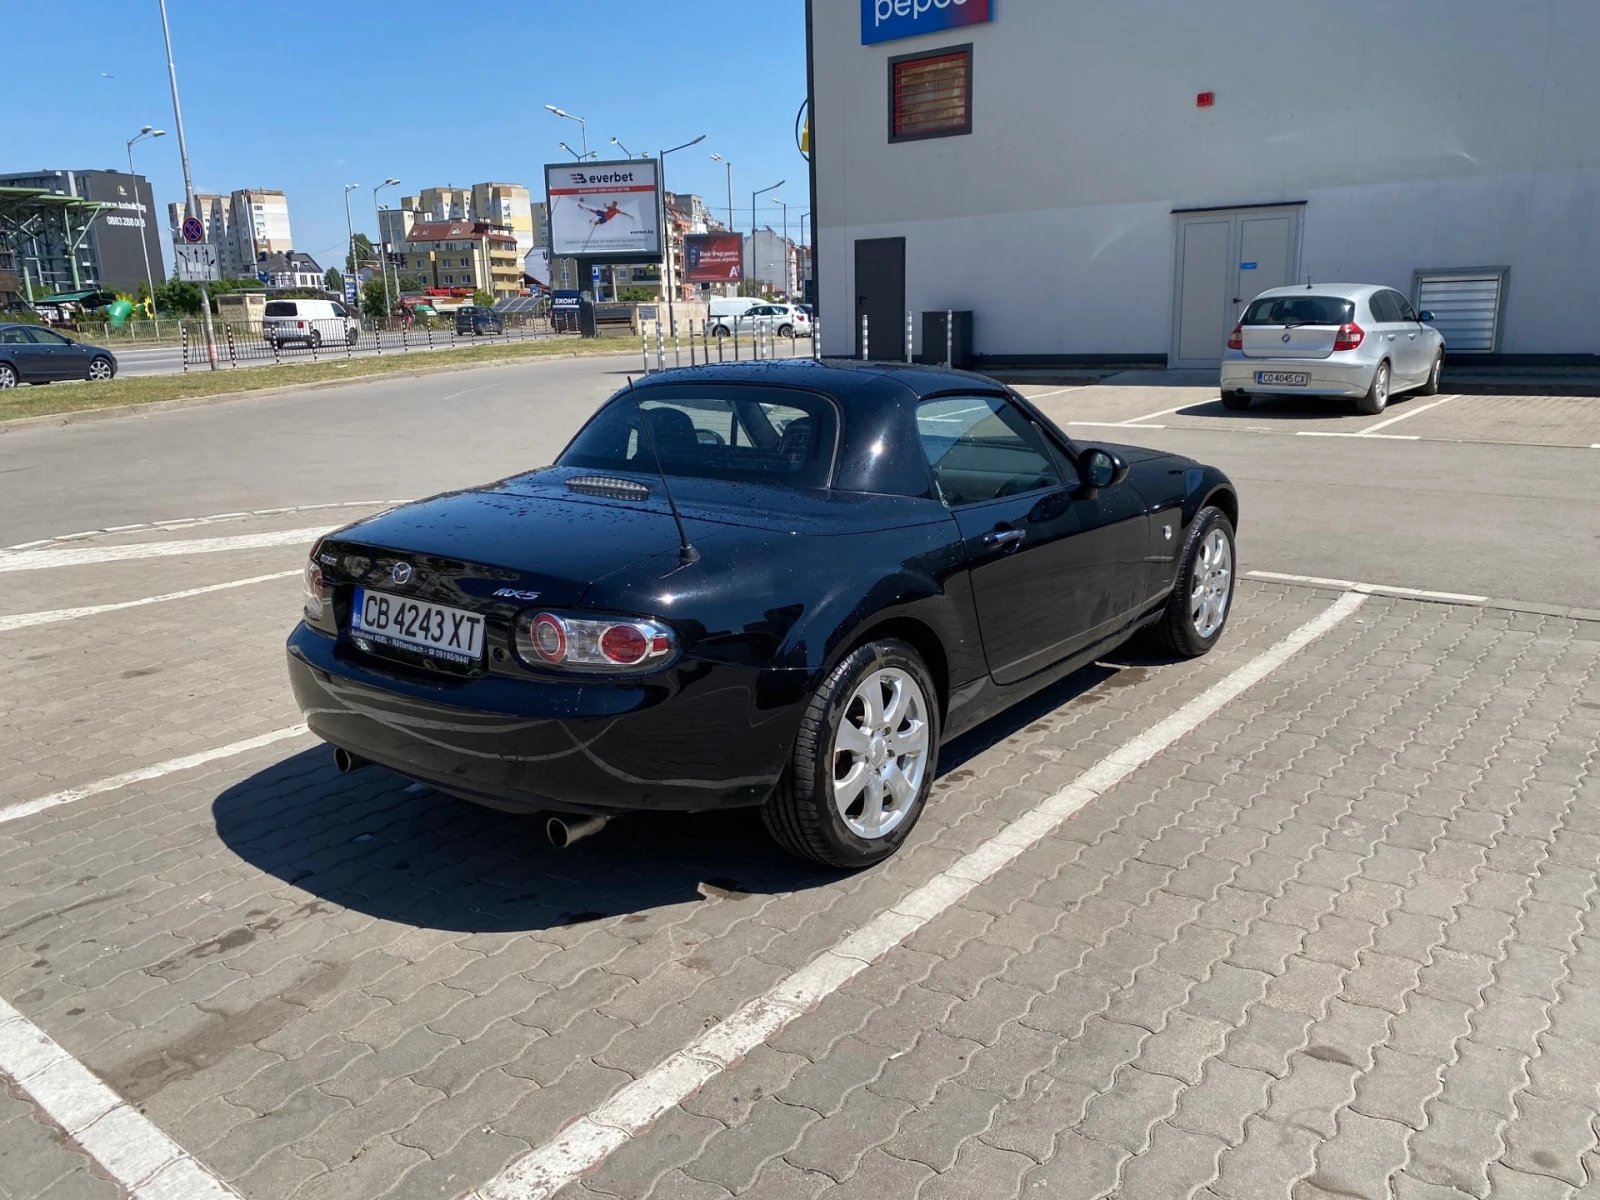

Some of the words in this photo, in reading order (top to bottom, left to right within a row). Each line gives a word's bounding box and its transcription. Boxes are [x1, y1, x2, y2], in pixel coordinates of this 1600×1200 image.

[875, 0, 968, 27] pep
[589, 171, 634, 184] everbet
[729, 264, 740, 278] A1
[1263, 374, 1274, 382] CO
[1275, 374, 1293, 383] 4045
[1294, 375, 1306, 383] CX
[492, 588, 541, 600] MX-5
[364, 595, 390, 630] CB
[393, 602, 445, 643] 4243
[447, 612, 480, 651] XT
[351, 628, 374, 640] Autohaus
[374, 634, 388, 644] IGEL
[391, 639, 424, 653] Röttenbach
